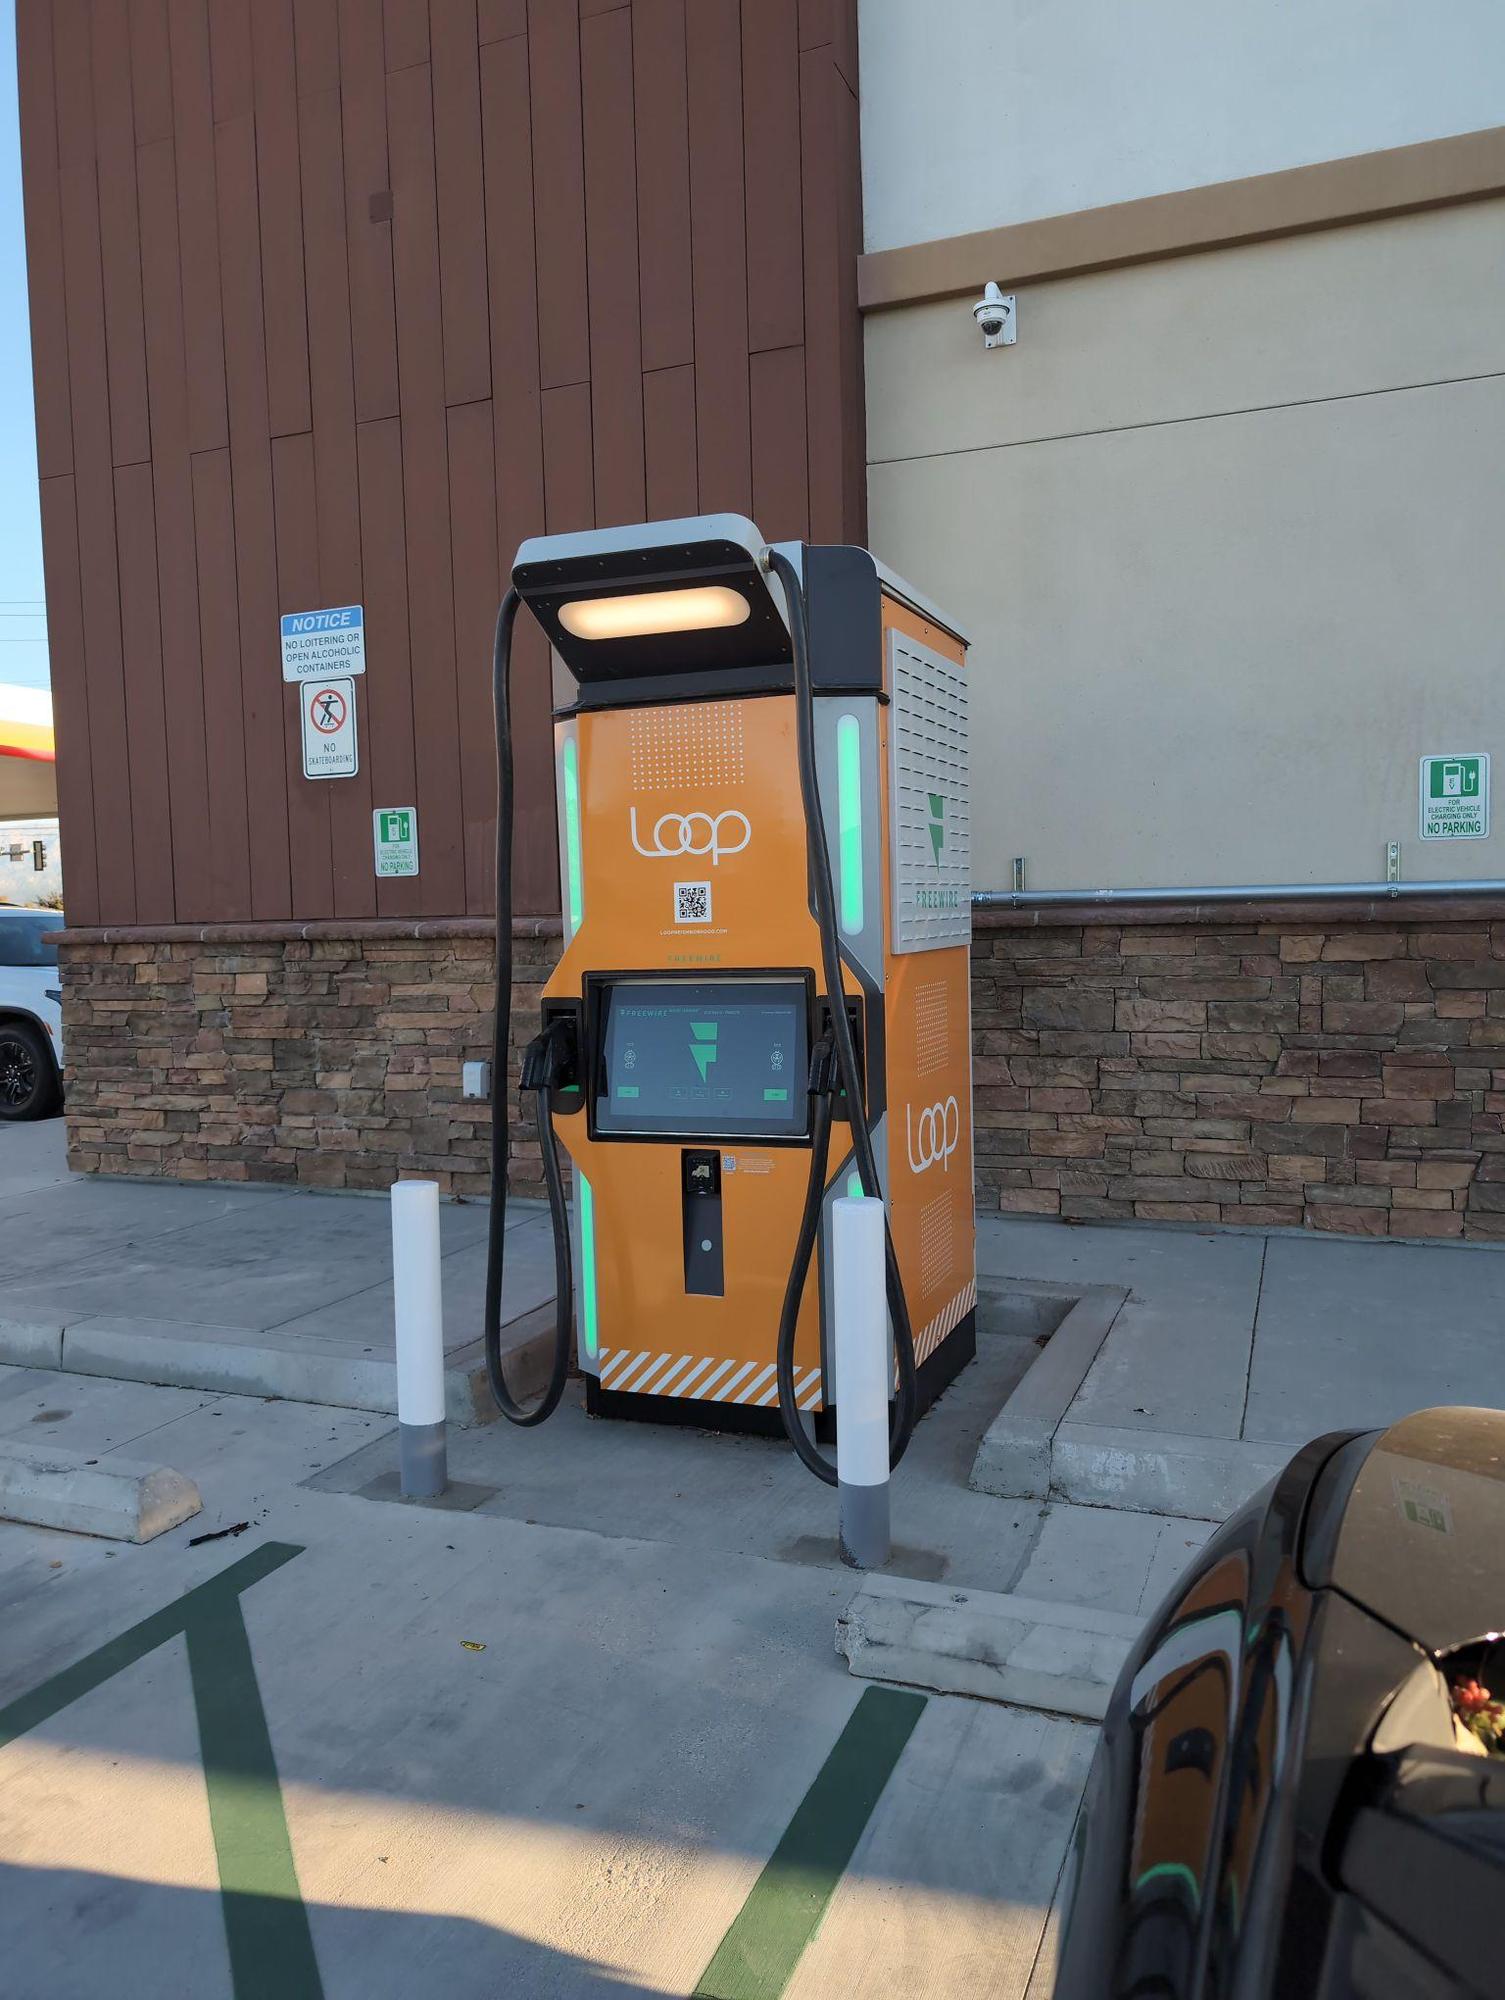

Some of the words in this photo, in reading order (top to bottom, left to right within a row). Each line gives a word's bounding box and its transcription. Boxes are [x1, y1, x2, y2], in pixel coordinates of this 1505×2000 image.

[292, 612, 352, 632] NOTICE
[285, 640, 298, 650] NO
[300, 634, 345, 648] LOITERING
[347, 632, 360, 642] OR
[286, 652, 309, 662] OPEN
[311, 645, 360, 659] ALCOHOLIC
[296, 659, 351, 673] CONTAINERS
[323, 743, 336, 753] NO
[308, 754, 353, 766] SKATEBOARDING
[1428, 806, 1455, 814] ELECTRIC
[1431, 812, 1461, 820] CHARGING
[1427, 822, 1440, 834] NO
[1442, 820, 1481, 834] PARKING
[916, 890, 959, 908] FREEWIRE
